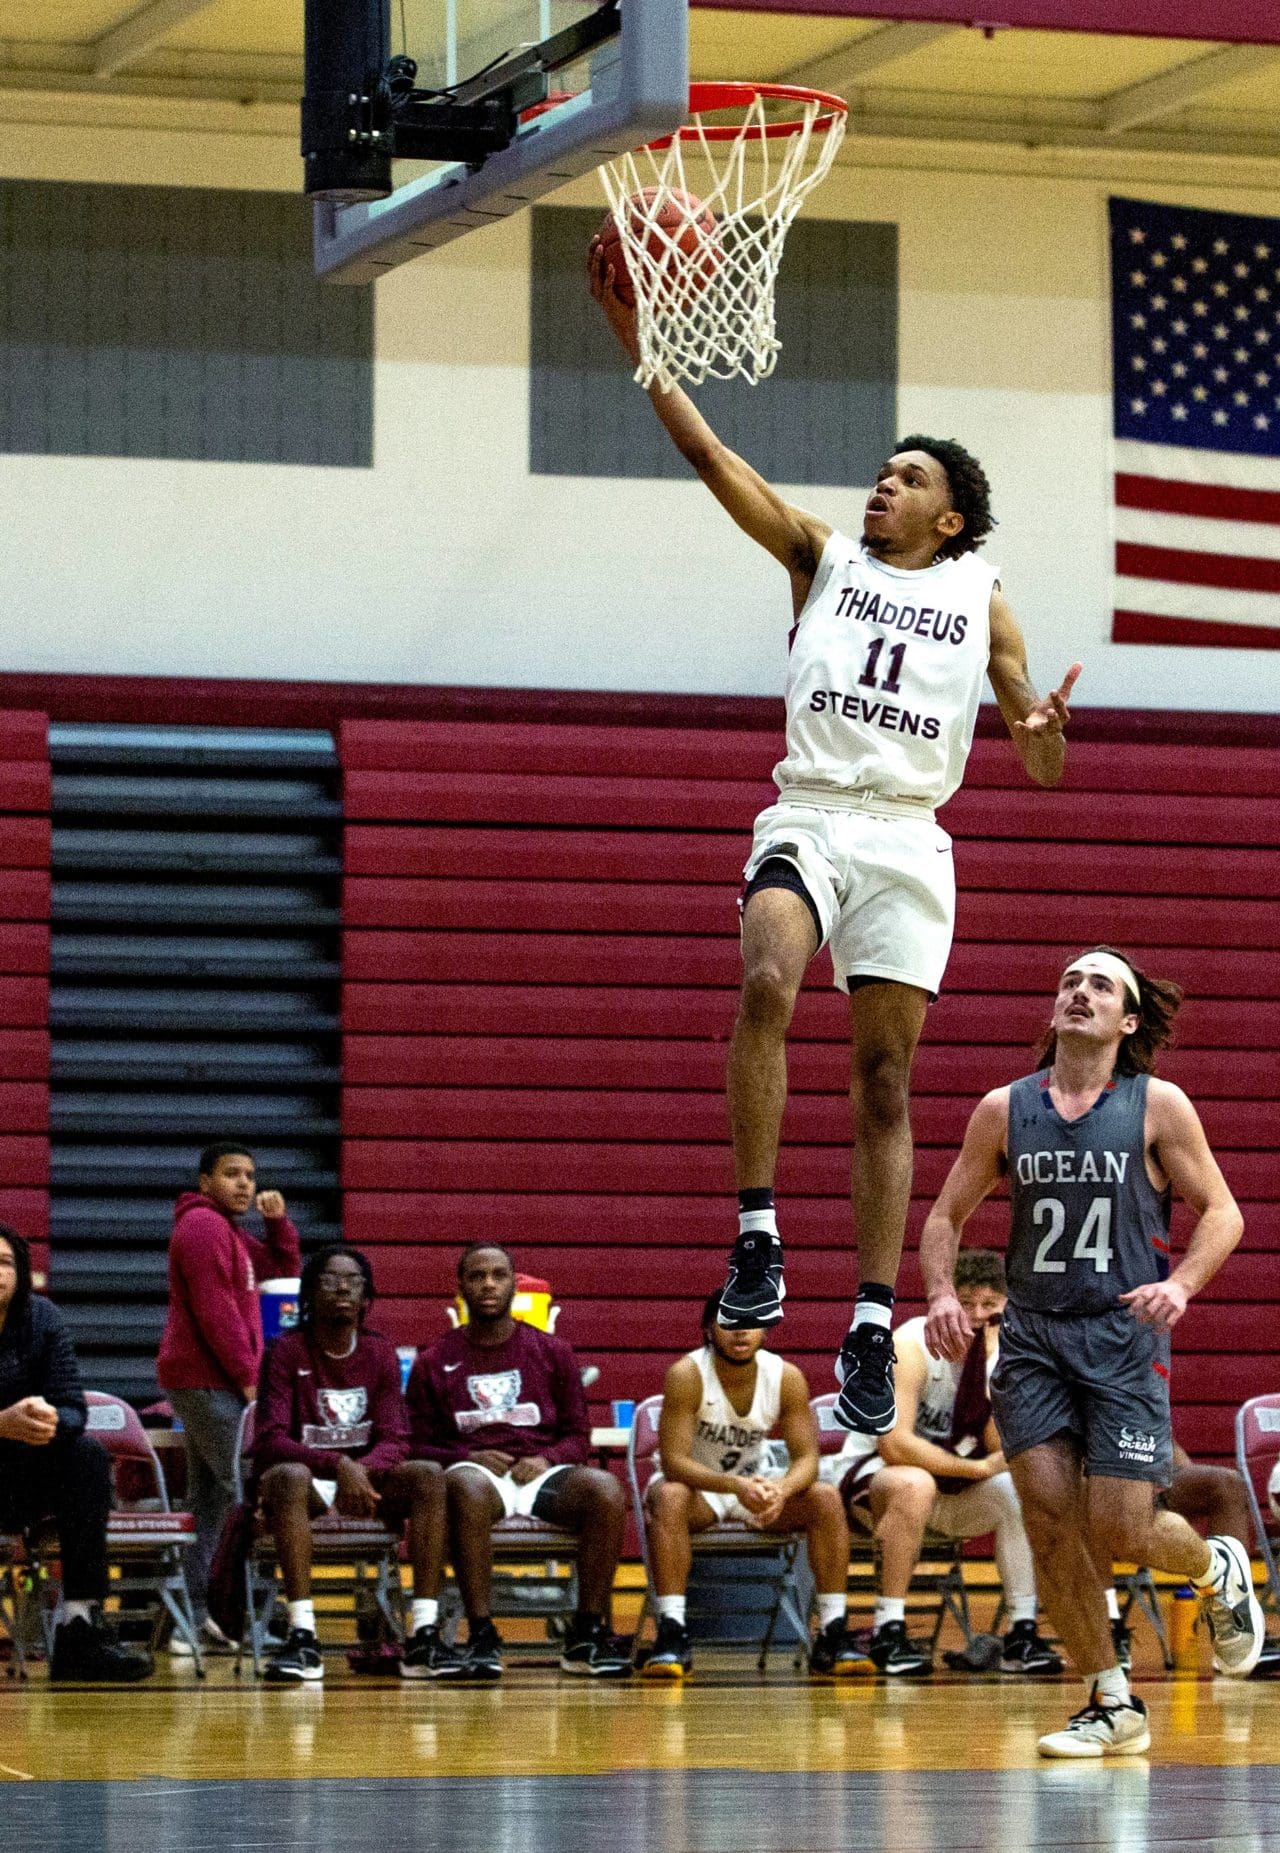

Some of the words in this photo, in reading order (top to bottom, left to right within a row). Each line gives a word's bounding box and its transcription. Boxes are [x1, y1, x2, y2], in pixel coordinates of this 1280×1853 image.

[835, 587, 968, 646] THADDEUS
[858, 637, 907, 694] 11
[809, 690, 941, 739] STEVENS
[1017, 1150, 1130, 1185] OCEAN
[1032, 1197, 1114, 1273] 24
[1119, 1440, 1156, 1452] OCEAN
[1119, 1451, 1154, 1463] VIKINGS
